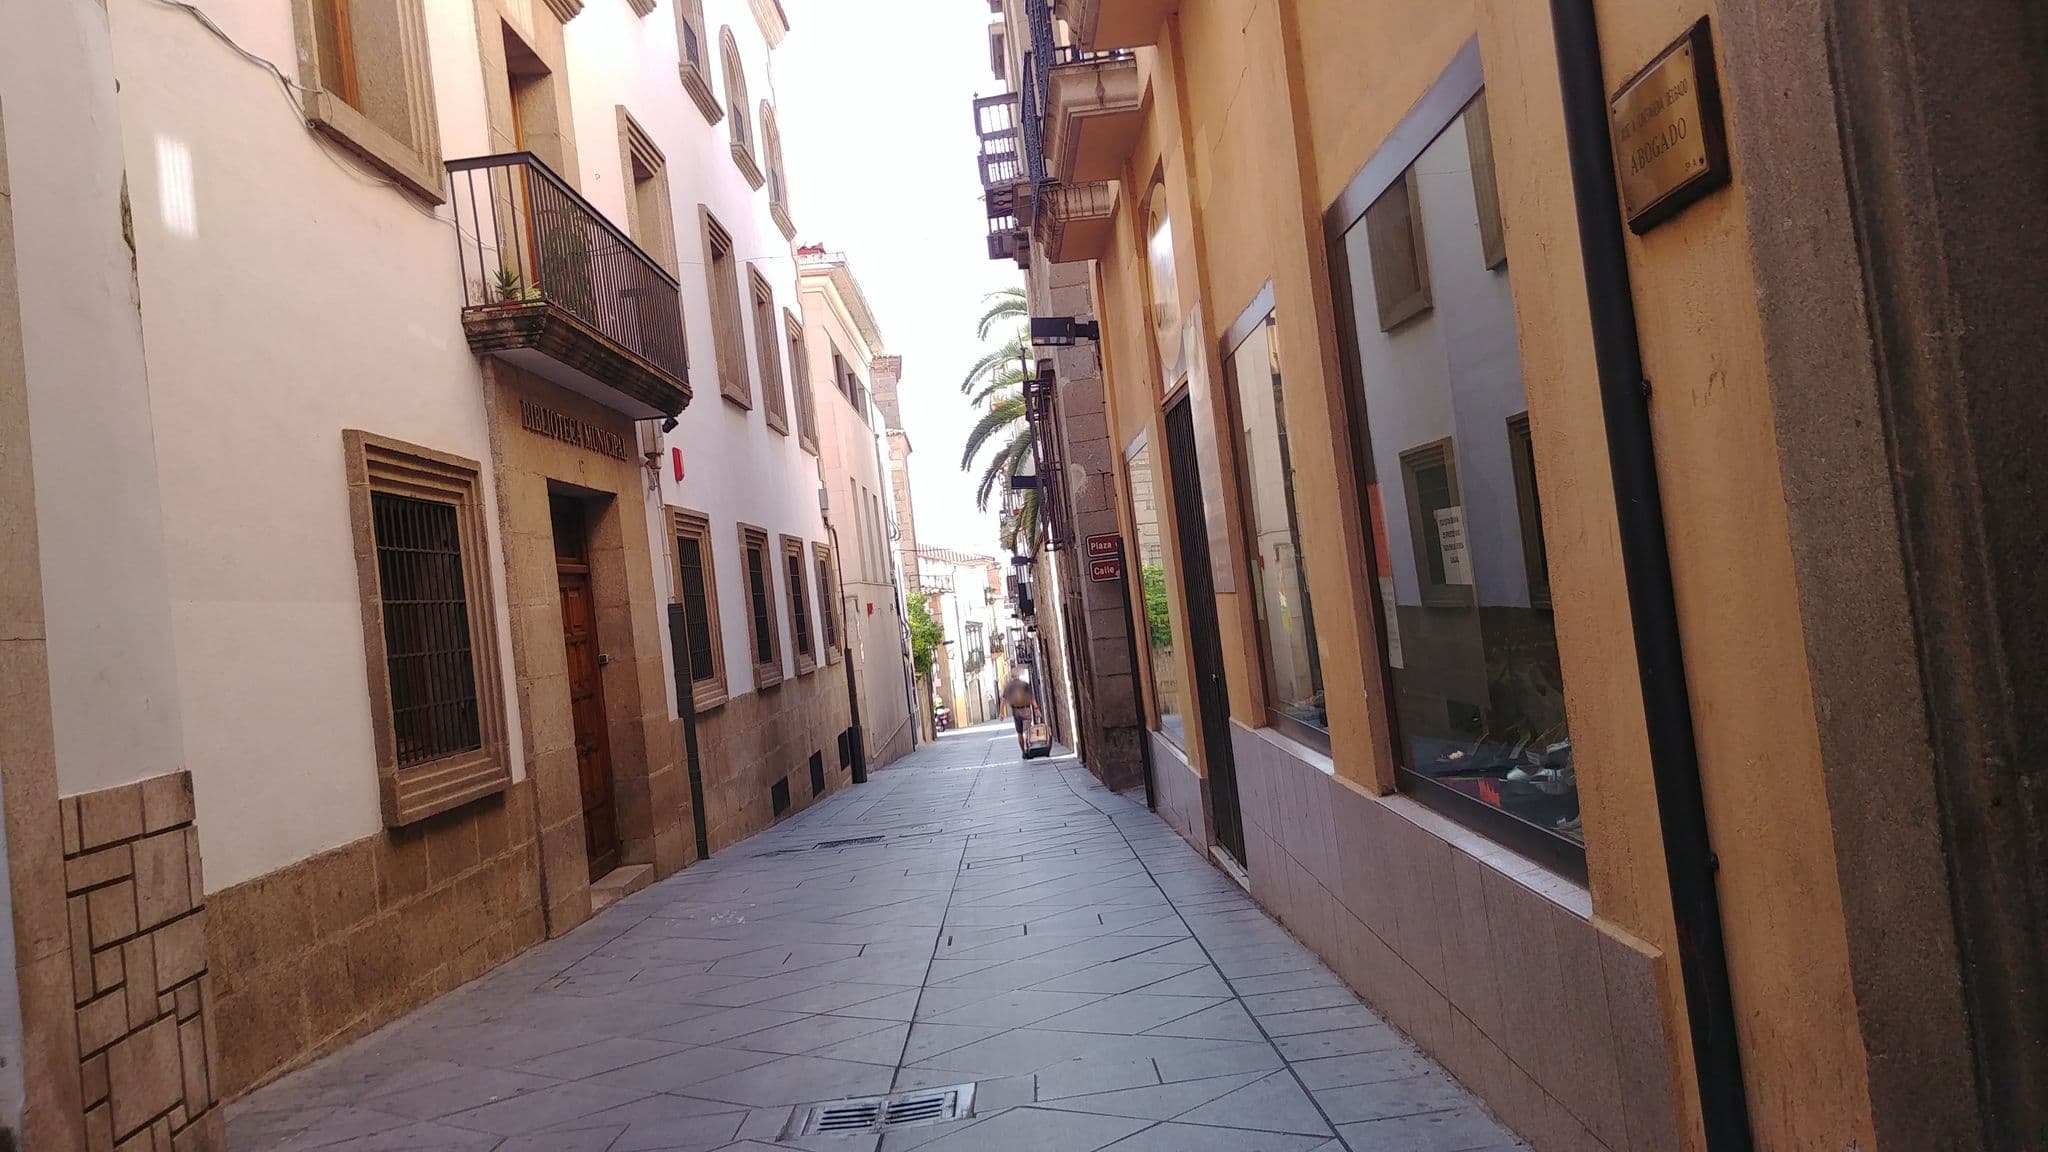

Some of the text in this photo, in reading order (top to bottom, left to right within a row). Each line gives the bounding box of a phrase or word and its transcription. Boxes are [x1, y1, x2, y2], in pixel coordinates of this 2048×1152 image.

[1630, 117, 1687, 176] ABOGADO
[520, 400, 627, 462] BIBLIOTECA MUNICIPAL
[1090, 542, 1111, 550] Plaza
[1094, 565, 1114, 575] Calle
